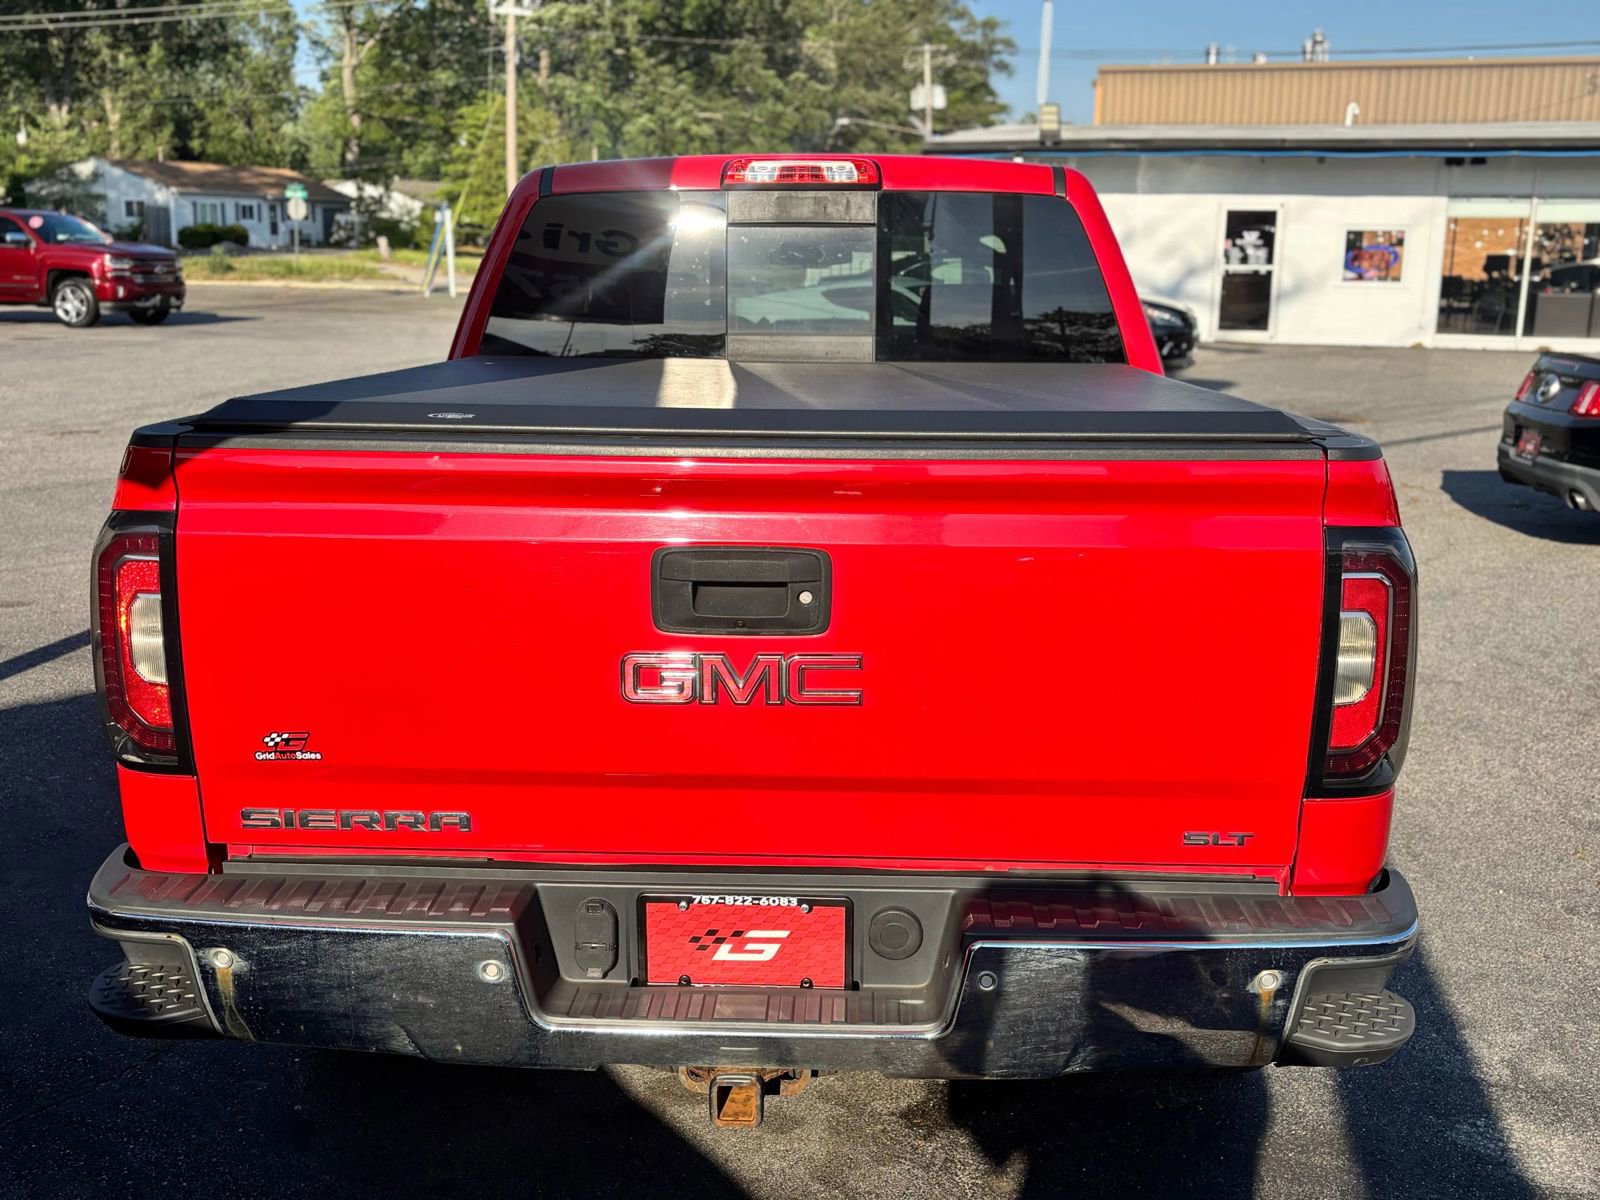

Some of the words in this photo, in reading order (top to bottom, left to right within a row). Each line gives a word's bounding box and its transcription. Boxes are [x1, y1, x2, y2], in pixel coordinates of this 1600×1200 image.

[619, 652, 864, 706] GMC
[255, 751, 322, 760] GridAutoSales
[241, 807, 472, 832] SIERRA
[1183, 831, 1256, 847] SLT
[692, 895, 798, 906] 757-822-6083
